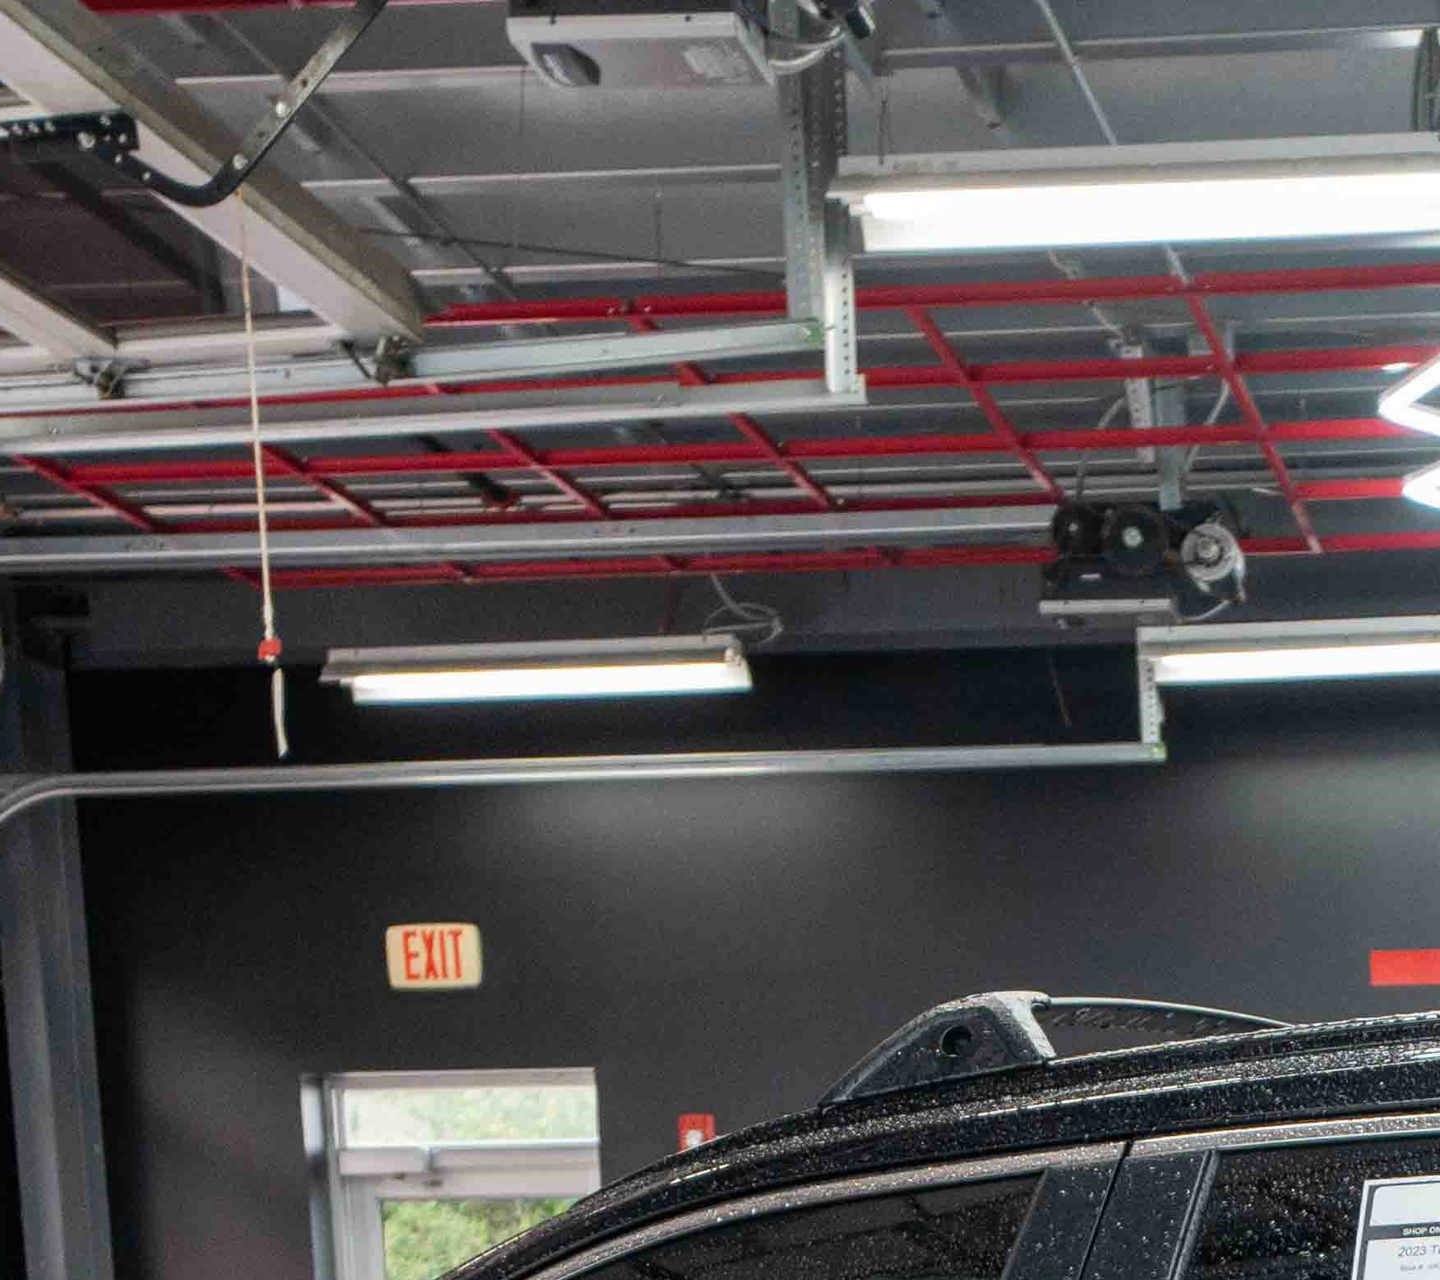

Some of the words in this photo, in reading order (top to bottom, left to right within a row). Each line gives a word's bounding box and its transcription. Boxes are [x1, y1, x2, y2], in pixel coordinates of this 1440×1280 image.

[402, 930, 463, 979] EXIT
[1402, 1226, 1428, 1237] SHOP
[1398, 1245, 1427, 1257] 2023
